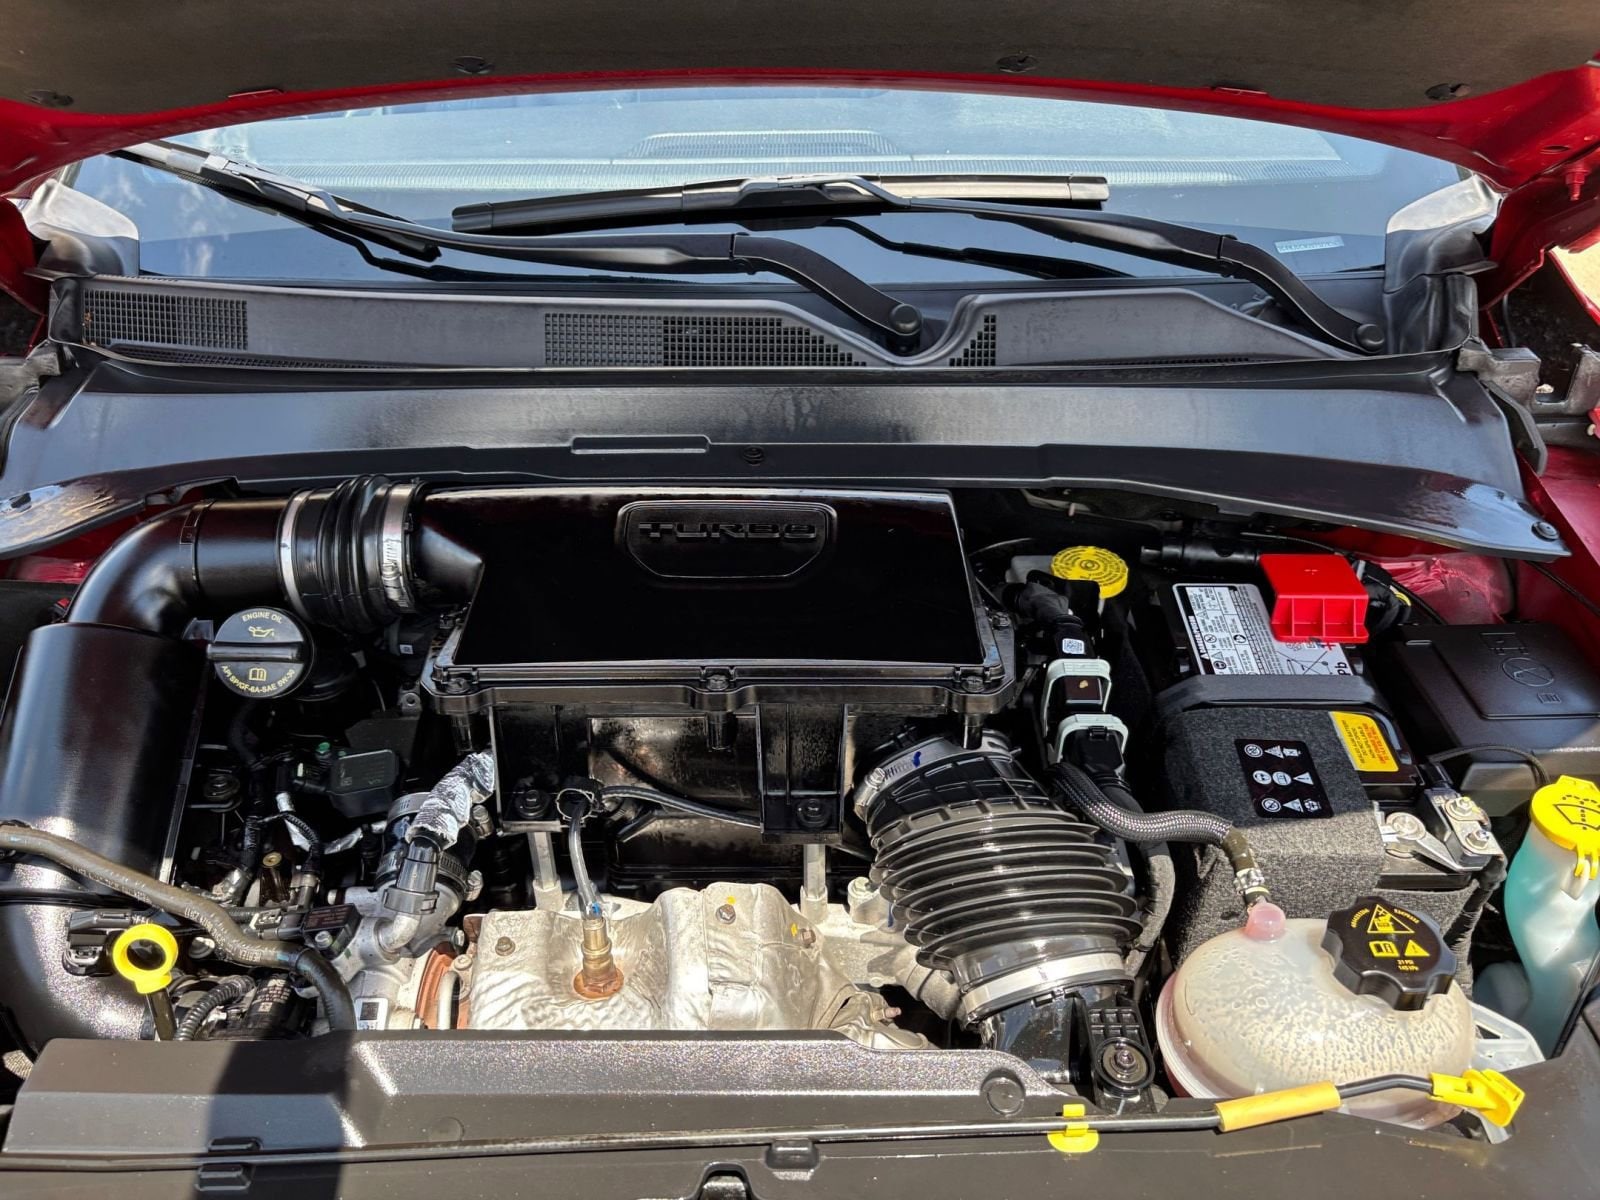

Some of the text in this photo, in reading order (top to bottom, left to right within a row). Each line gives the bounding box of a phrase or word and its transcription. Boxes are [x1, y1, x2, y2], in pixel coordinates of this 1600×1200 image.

[637, 522, 817, 540] TURBO
[242, 611, 283, 624] ENGINE OIL
[221, 665, 231, 678] API
[277, 668, 296, 687] 5W-30
[1334, 661, 1351, 676] Pb
